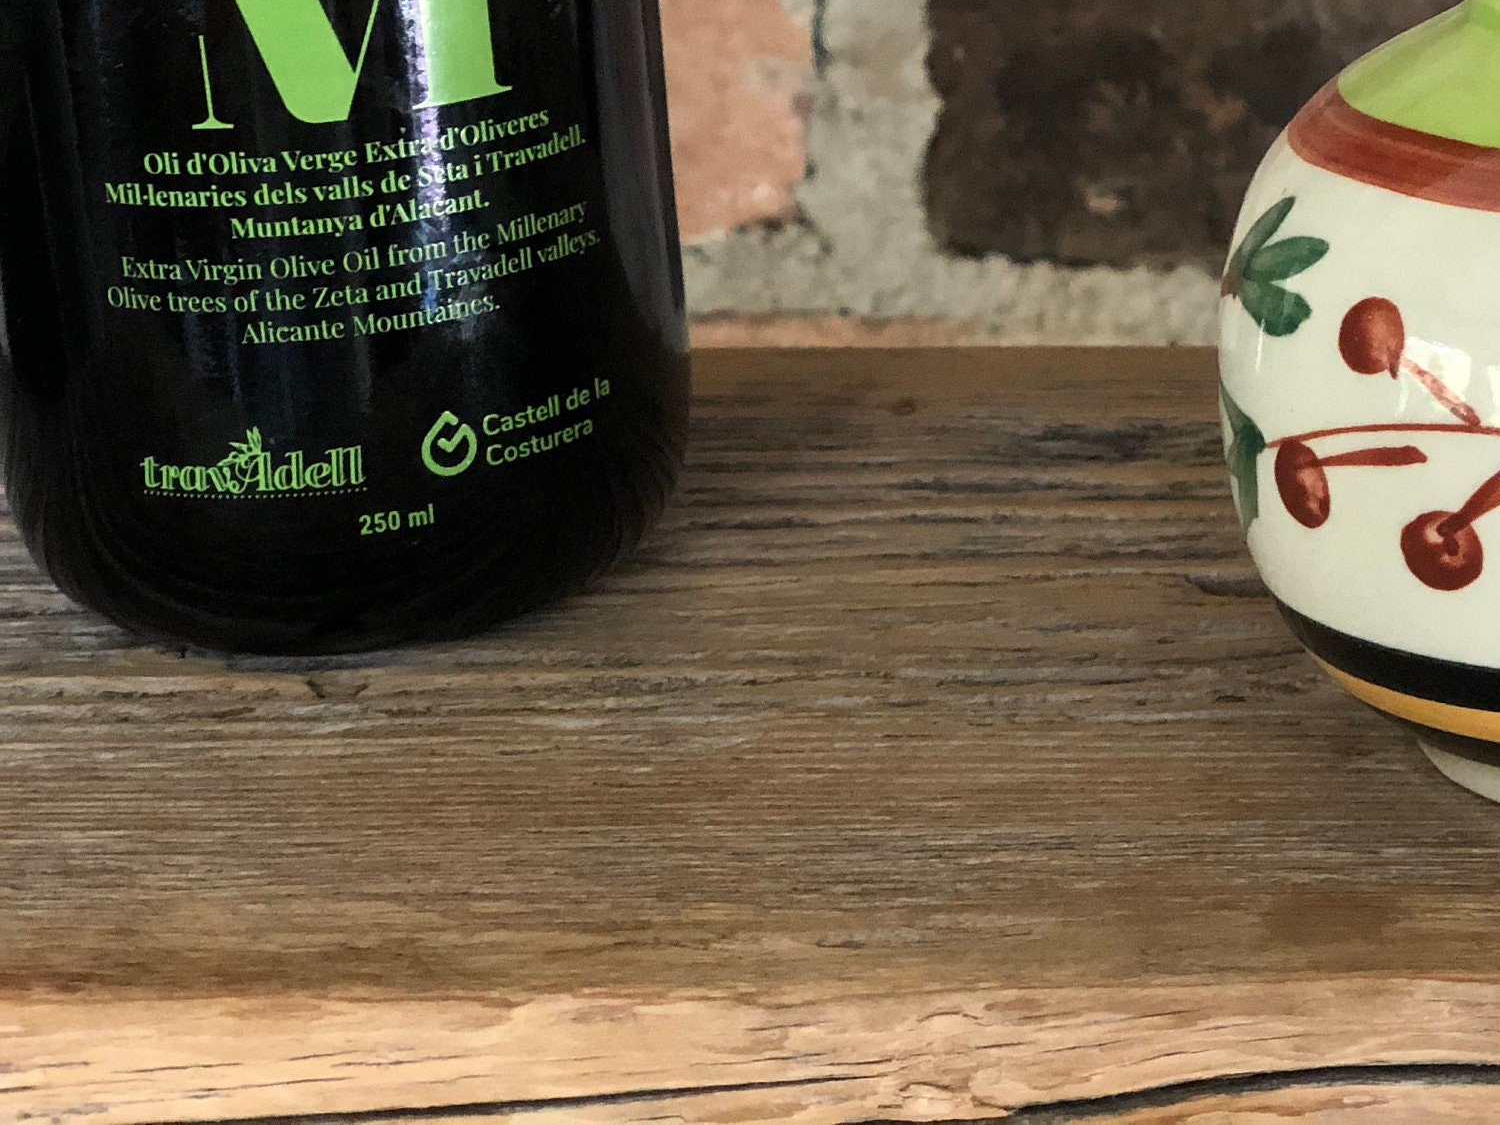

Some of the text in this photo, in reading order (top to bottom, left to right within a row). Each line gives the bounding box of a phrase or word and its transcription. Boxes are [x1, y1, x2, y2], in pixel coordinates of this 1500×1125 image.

[144, 109, 550, 175] Oli d'Oliva Verge Extra d'Oliveres
[254, 181, 307, 206] dels
[313, 175, 375, 202] valls
[380, 170, 411, 194] de
[417, 162, 470, 188] Seta
[474, 154, 483, 177] i
[486, 124, 587, 173] Travadell.
[121, 200, 588, 285] Extra Virgin Olive Oil from the Millenary
[230, 189, 490, 240] Muntanya d'Alacant.
[107, 227, 601, 313] Olive trees of the Zeta and Travadell valleys.
[242, 293, 500, 344] Alicante Mountaines.
[483, 377, 611, 437] Castell de la
[486, 416, 594, 466] Costurera
[359, 503, 435, 536] 250 ml
